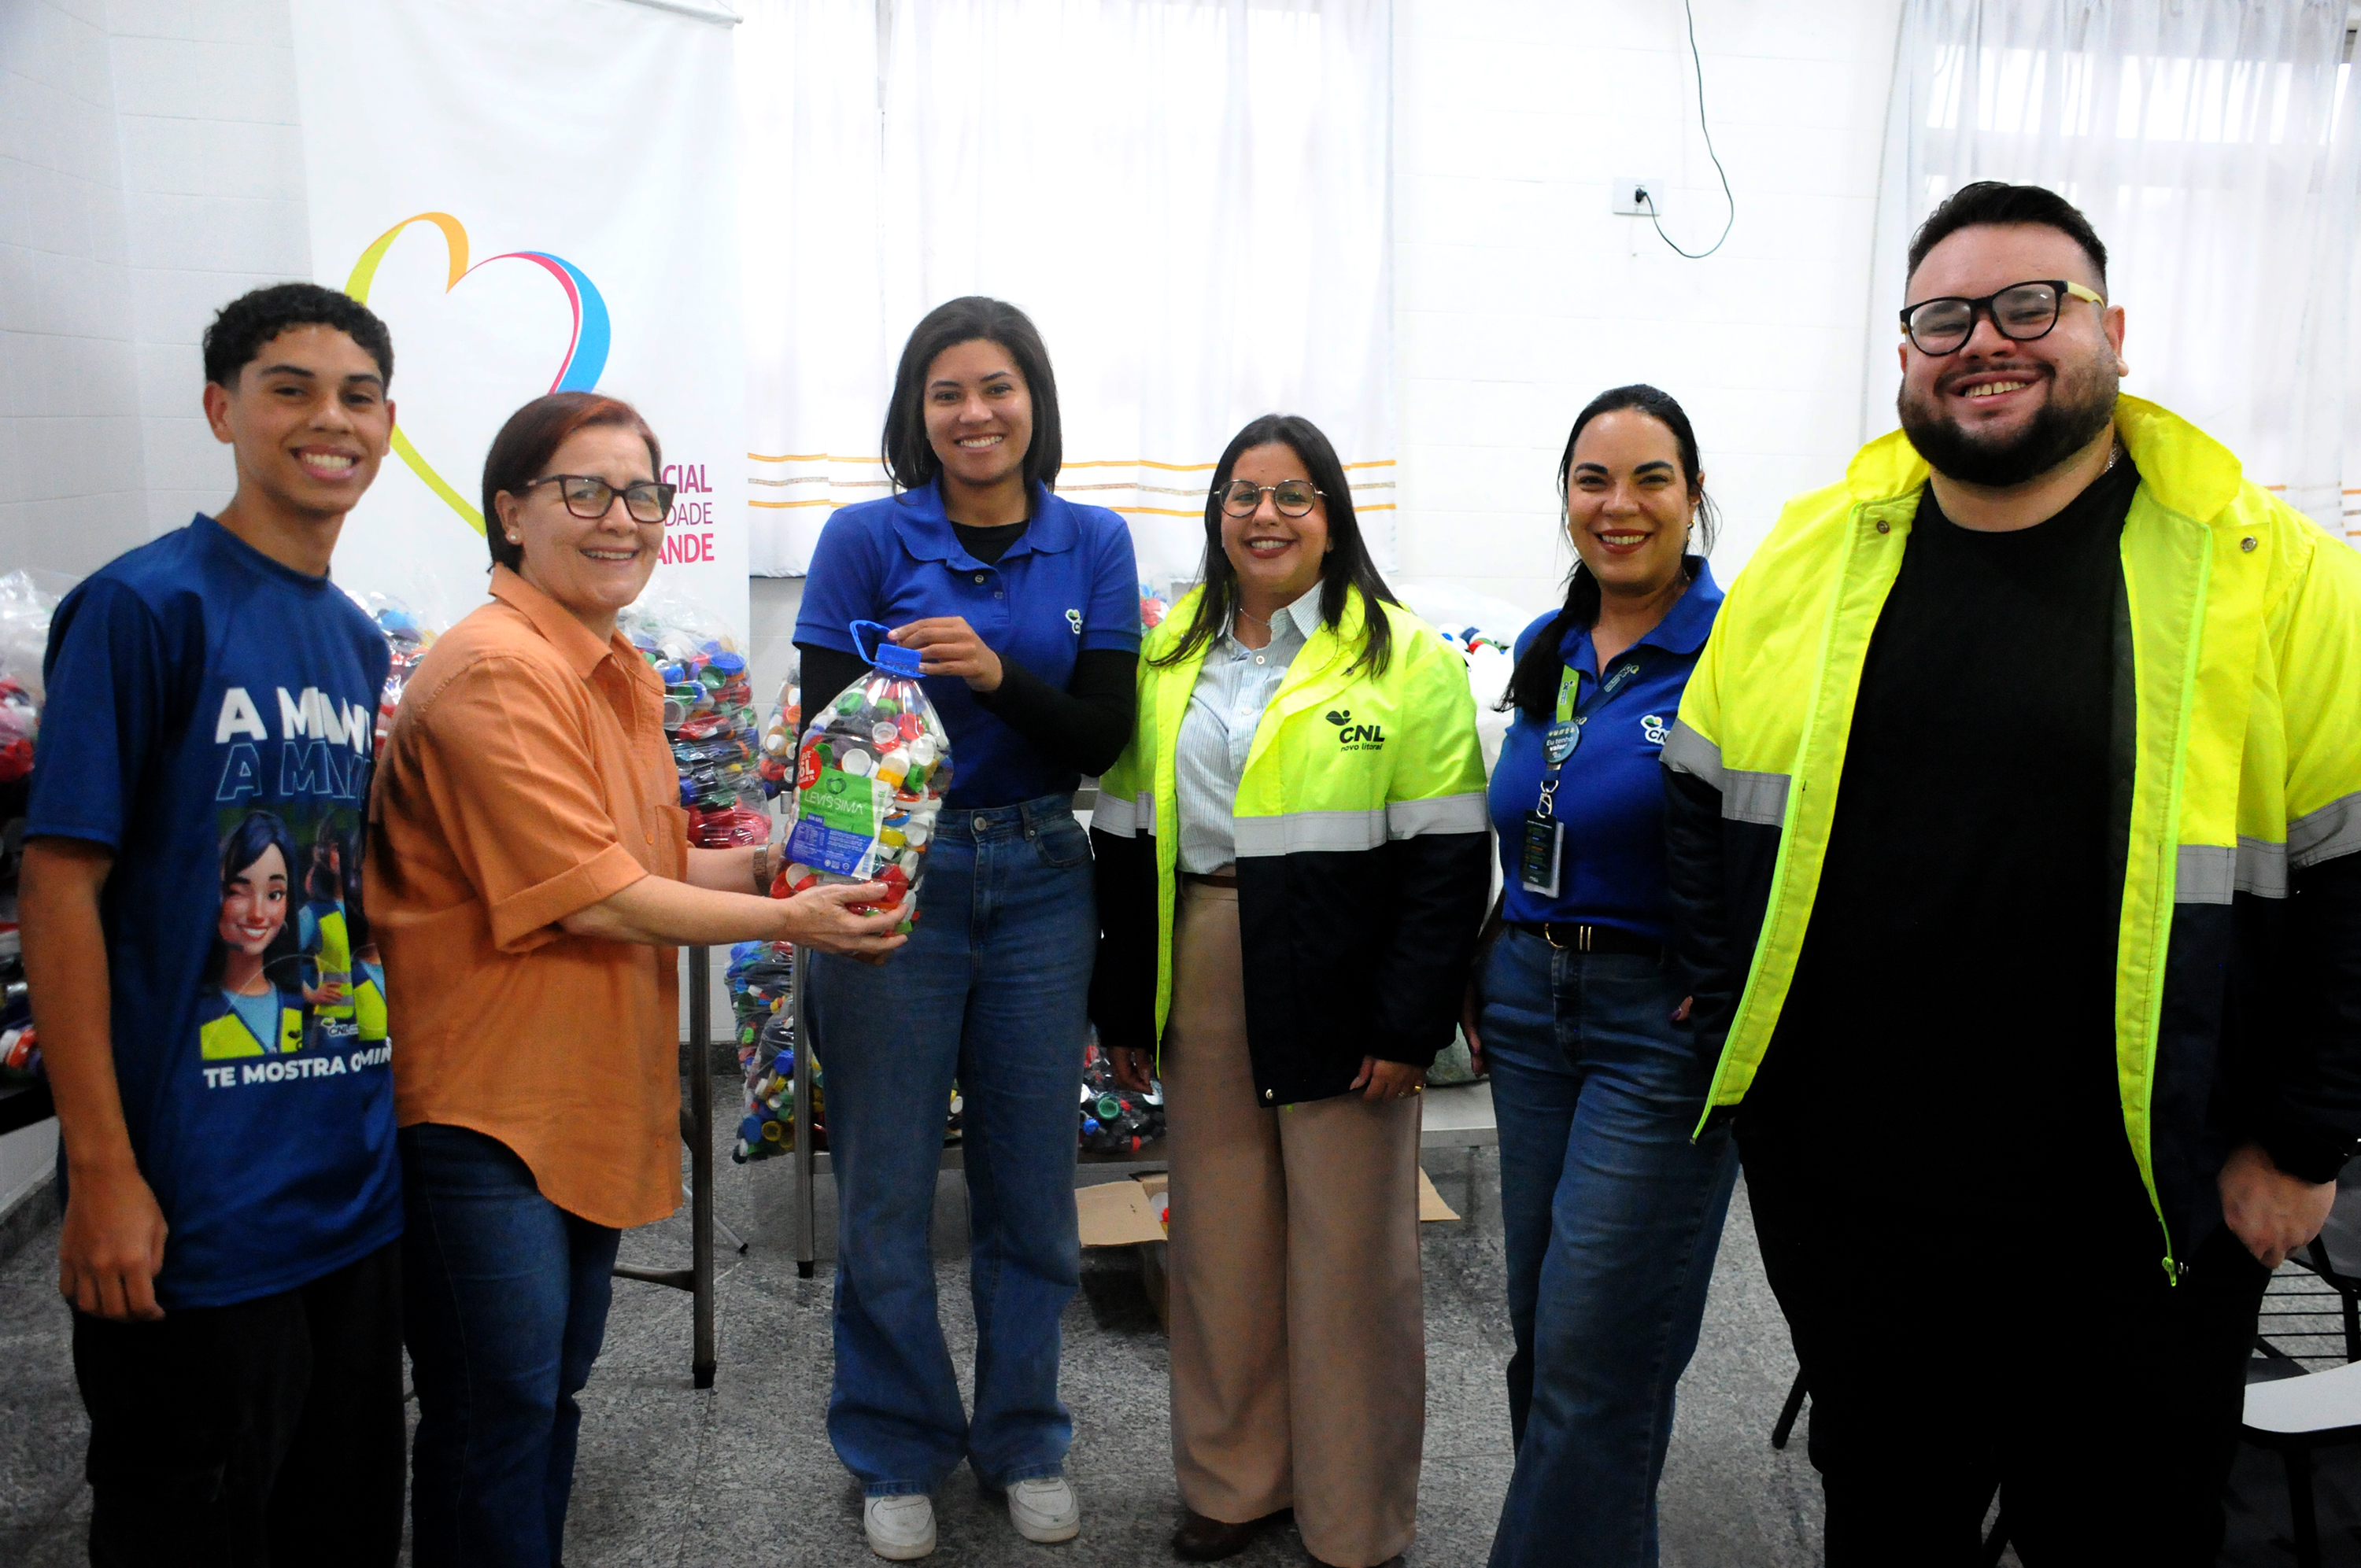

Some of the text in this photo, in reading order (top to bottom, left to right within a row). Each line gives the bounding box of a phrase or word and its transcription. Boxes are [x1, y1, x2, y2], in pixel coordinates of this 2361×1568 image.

[663, 464, 712, 493] CIAL
[665, 502, 713, 526] DADE
[657, 533, 715, 565] ANDE
[215, 687, 268, 743] A
[1339, 725, 1385, 743] CNL
[1555, 736, 1573, 744] tenho
[1649, 730, 1668, 742] CN
[216, 743, 262, 801] A
[203, 1066, 236, 1089] TE
[242, 1056, 347, 1085] MOSTRA
